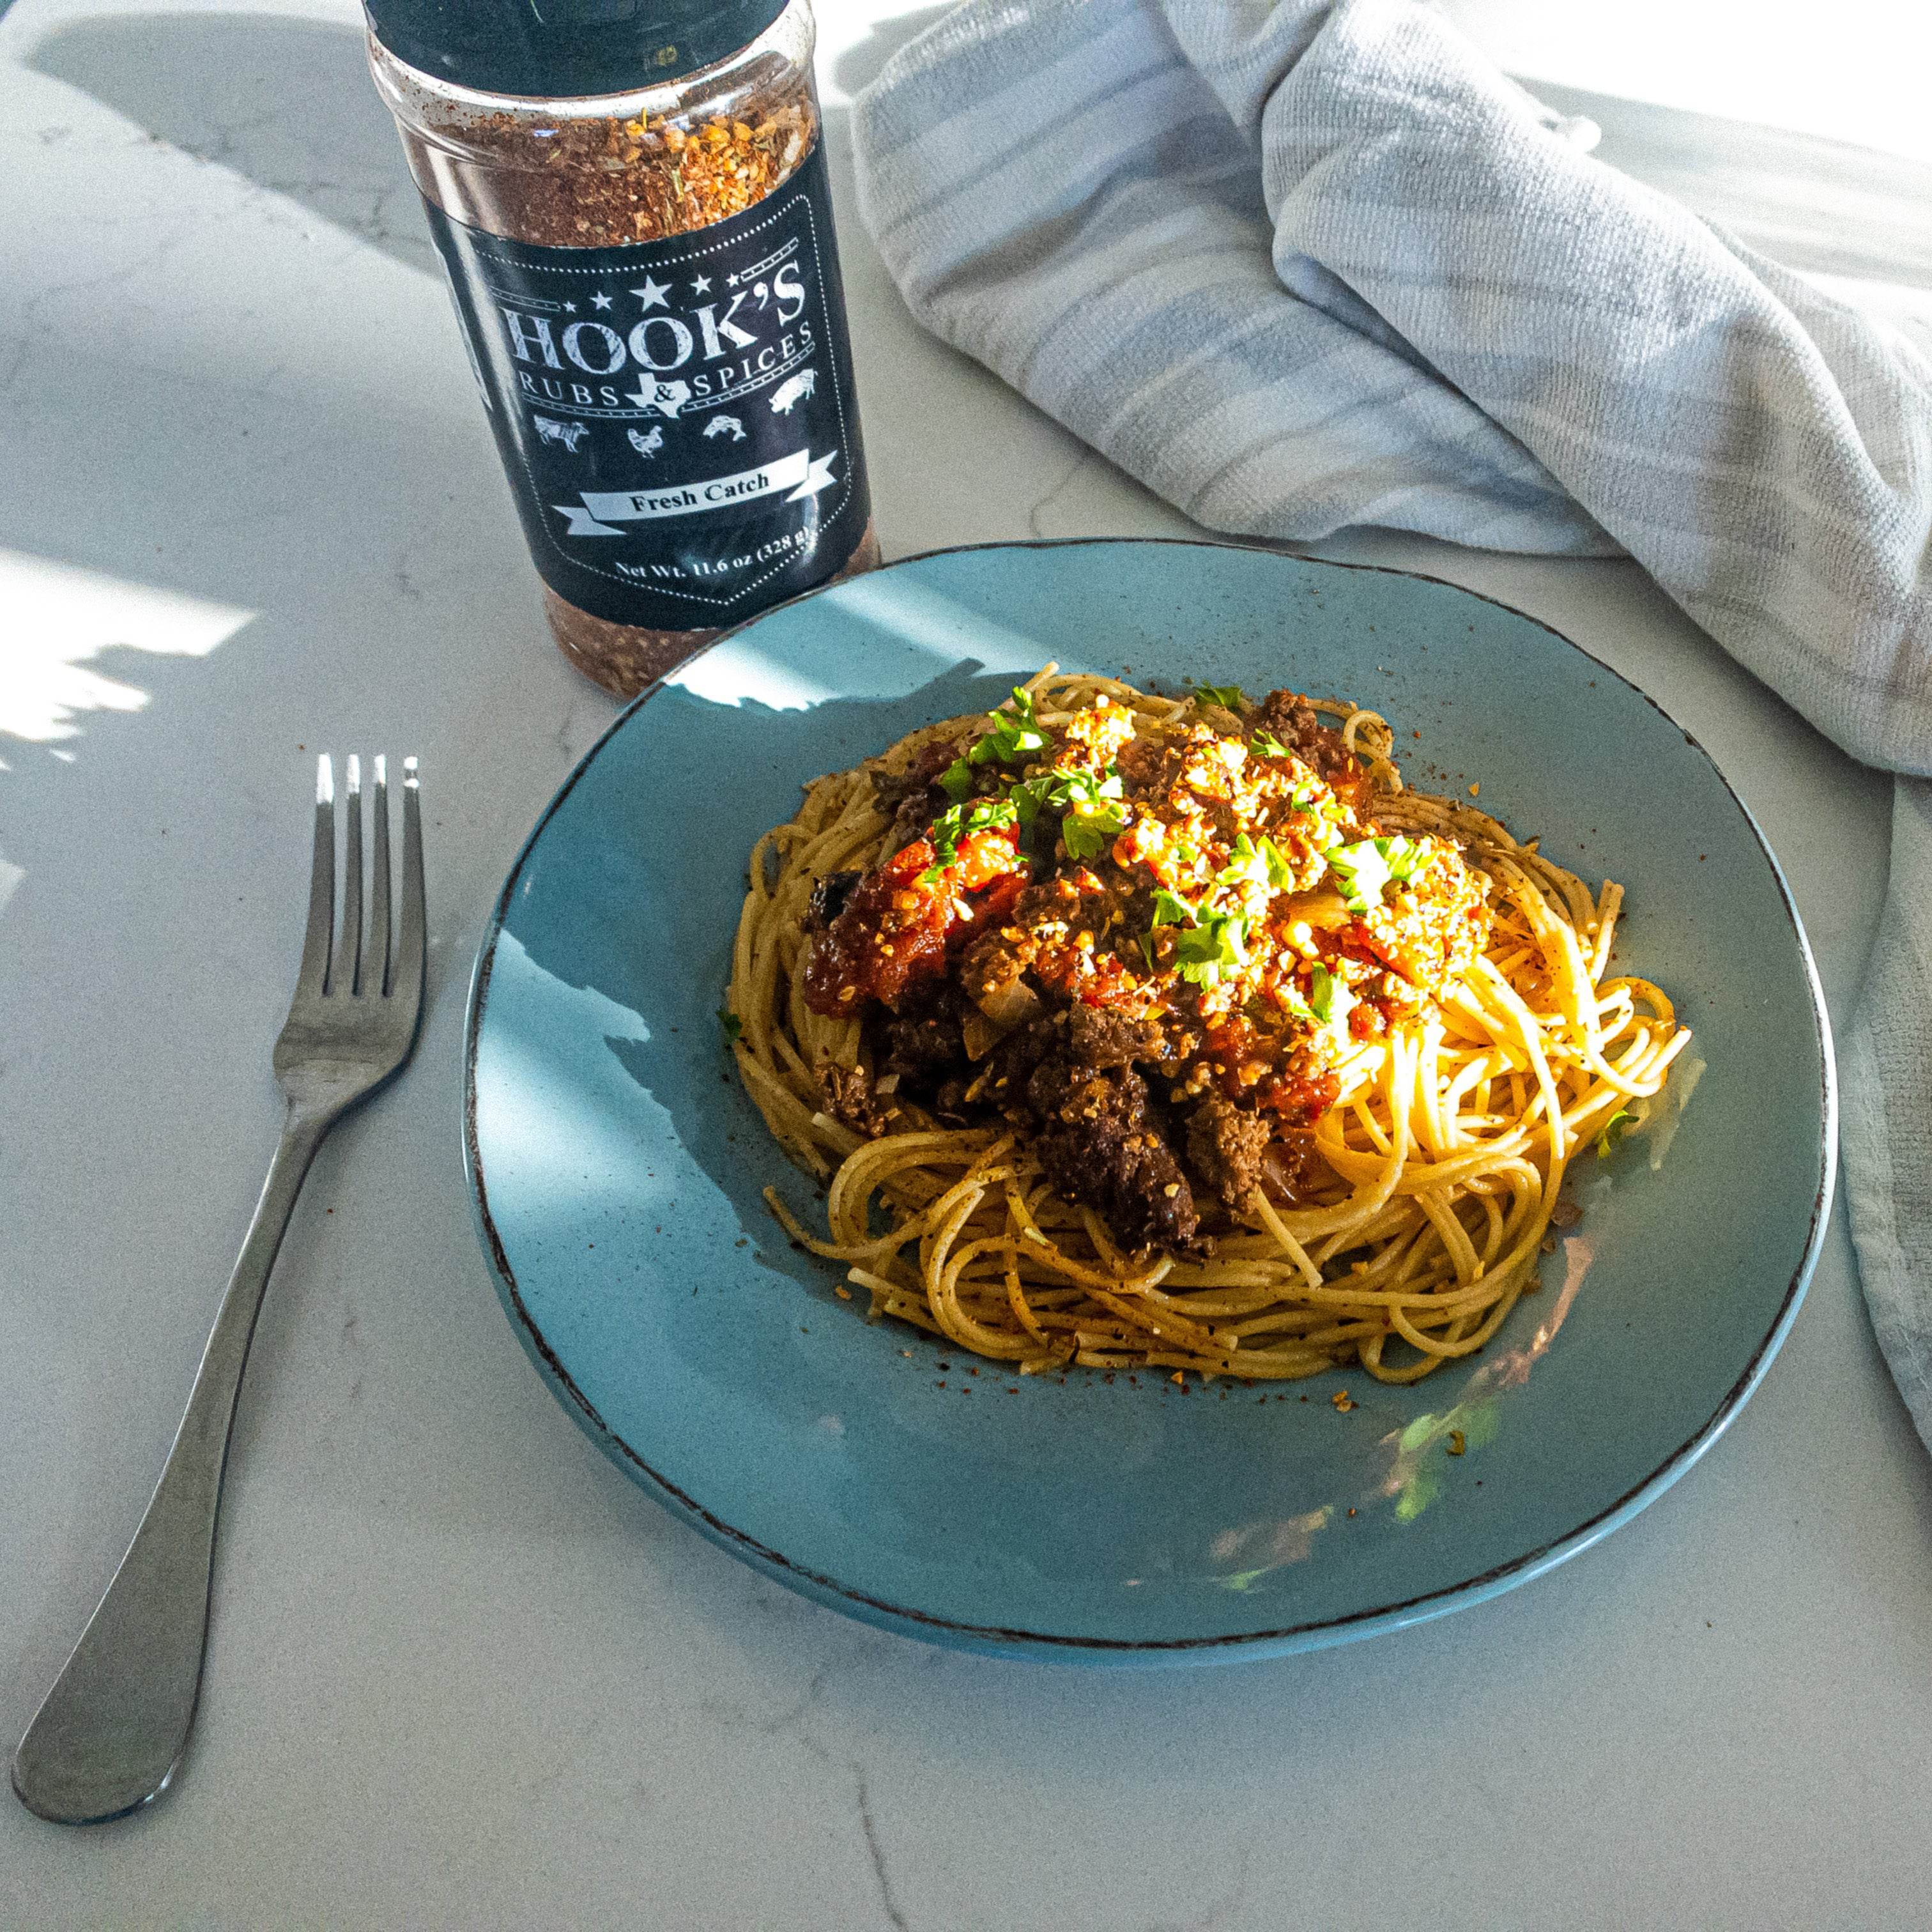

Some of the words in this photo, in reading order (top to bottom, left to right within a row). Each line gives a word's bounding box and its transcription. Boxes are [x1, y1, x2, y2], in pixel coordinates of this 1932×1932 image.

[500, 259, 806, 375] HOOK'S
[519, 371, 618, 406] RUBS
[693, 321, 813, 397] SPICES
[630, 491, 697, 512] Fresh
[705, 474, 769, 500] Catch
[615, 562, 647, 578] Net
[650, 565, 686, 578] Wt.
[693, 559, 728, 576] 11.6
[733, 555, 753, 569] oz
[756, 535, 792, 563] (328
